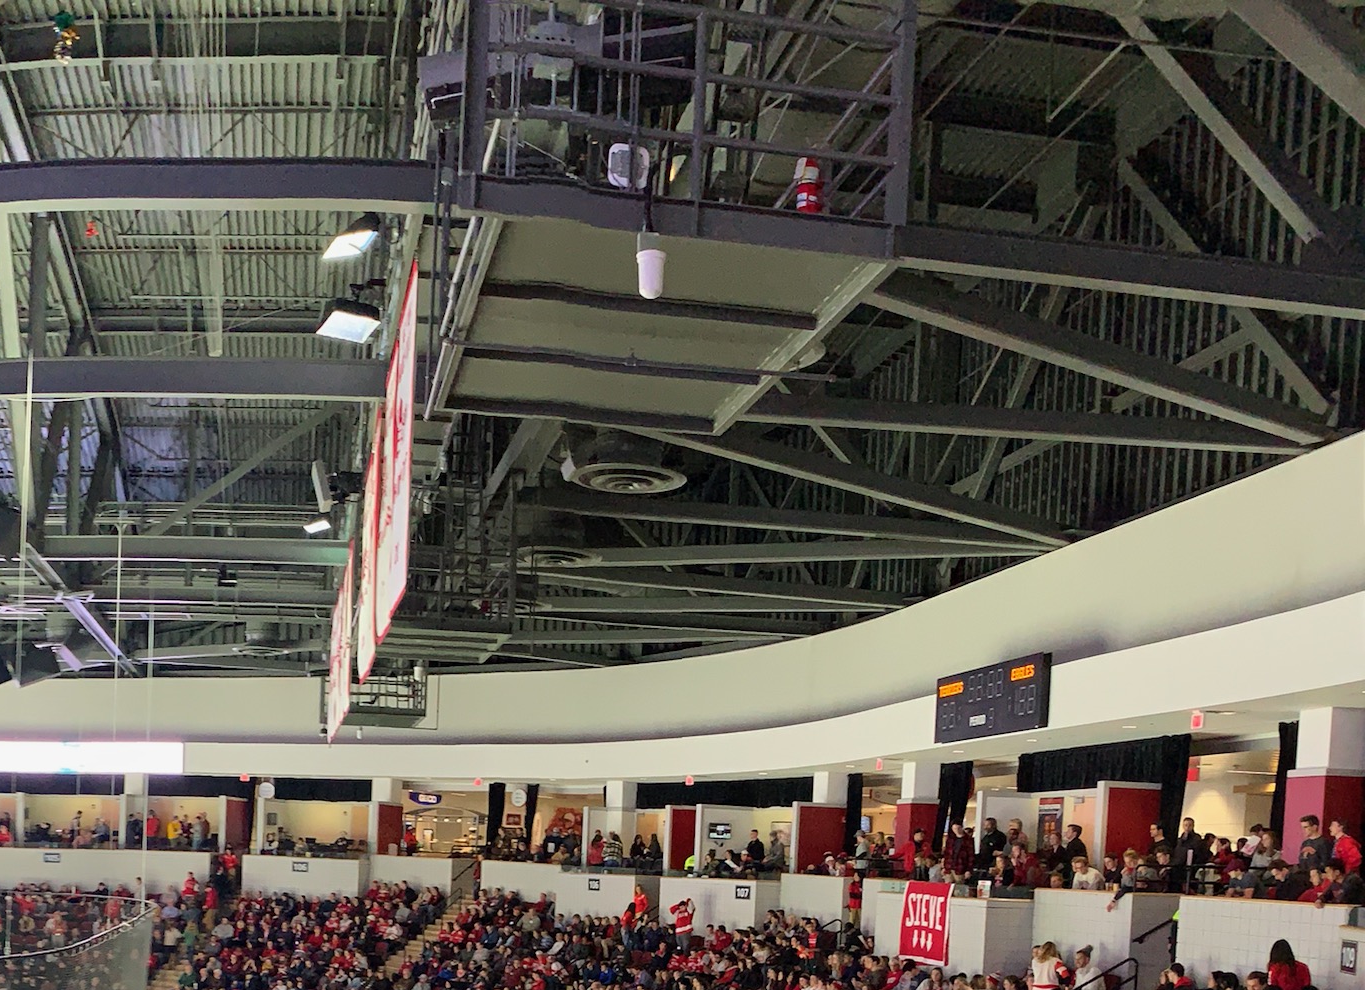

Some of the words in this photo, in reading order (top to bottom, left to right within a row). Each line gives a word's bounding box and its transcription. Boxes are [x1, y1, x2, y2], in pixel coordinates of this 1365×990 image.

[589, 880, 599, 889] 106
[737, 888, 749, 898] 107
[905, 892, 945, 931] SIEVE
